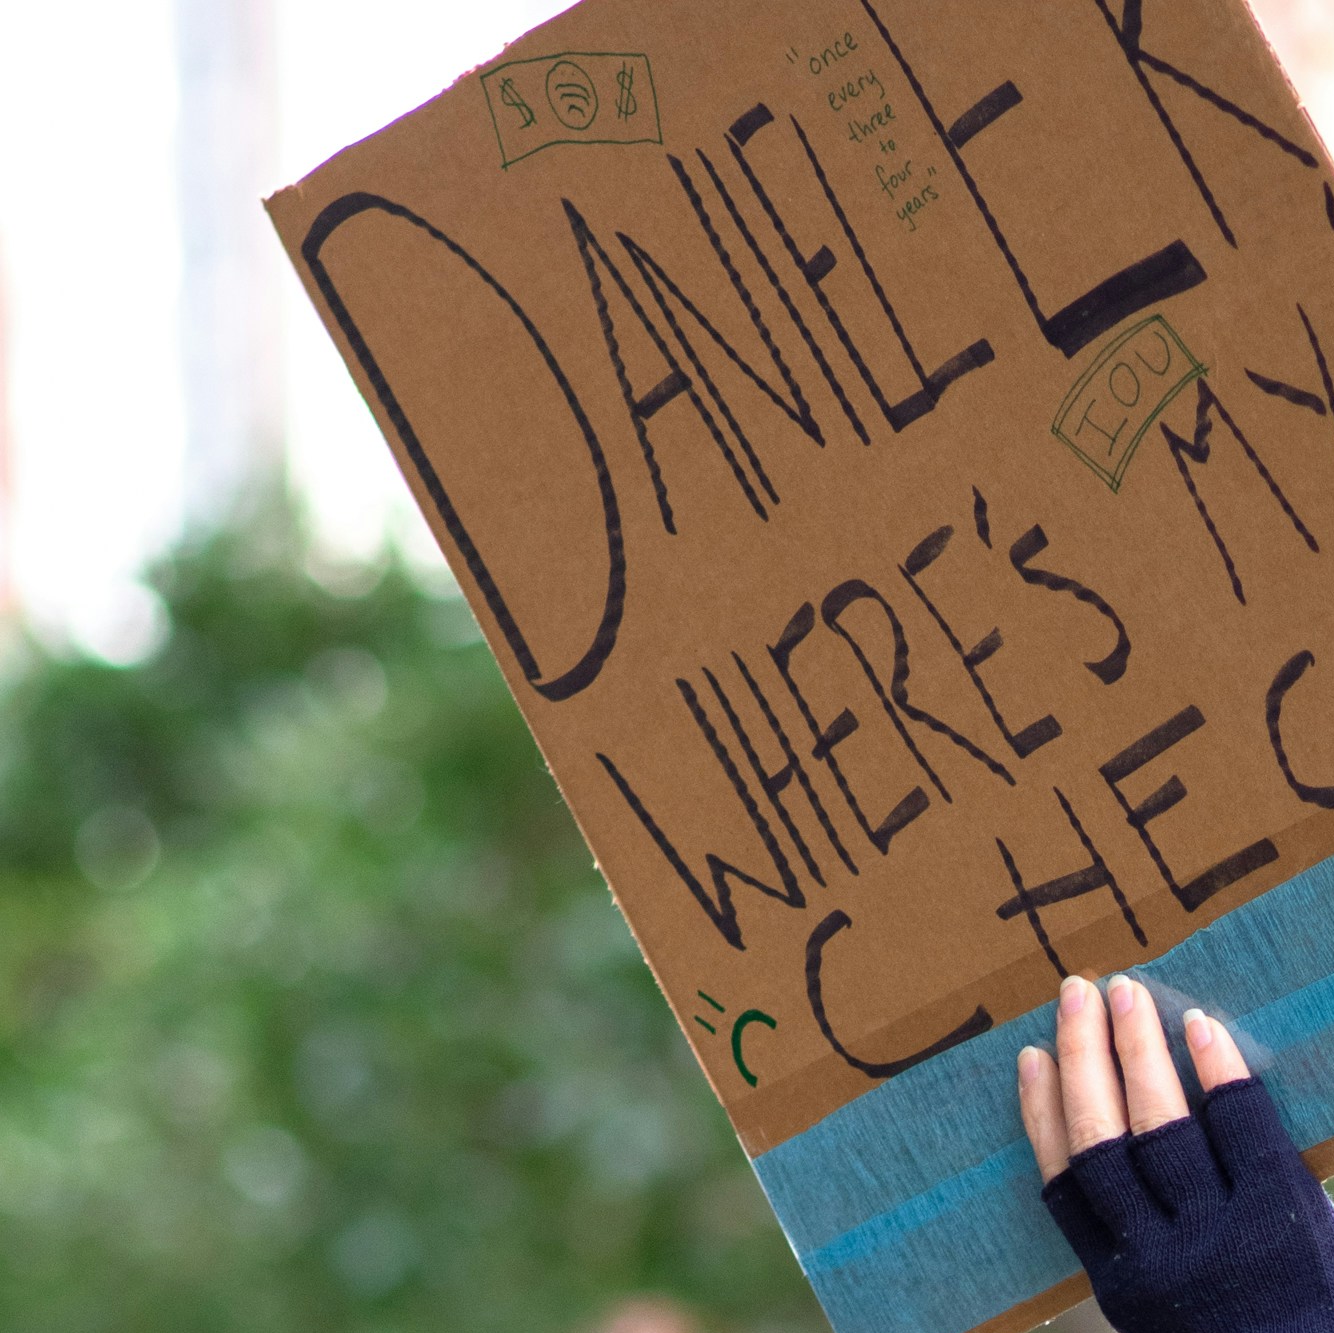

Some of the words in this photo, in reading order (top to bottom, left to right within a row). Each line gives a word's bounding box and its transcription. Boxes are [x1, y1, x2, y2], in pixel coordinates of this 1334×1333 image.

[827, 68, 886, 112] every
[847, 103, 897, 144] three
[879, 138, 897, 154] to
[874, 159, 912, 200] four
[301, 102, 996, 702] DANIEL
[1074, 330, 1171, 457] IOU
[595, 484, 1132, 951] WHERE'S
